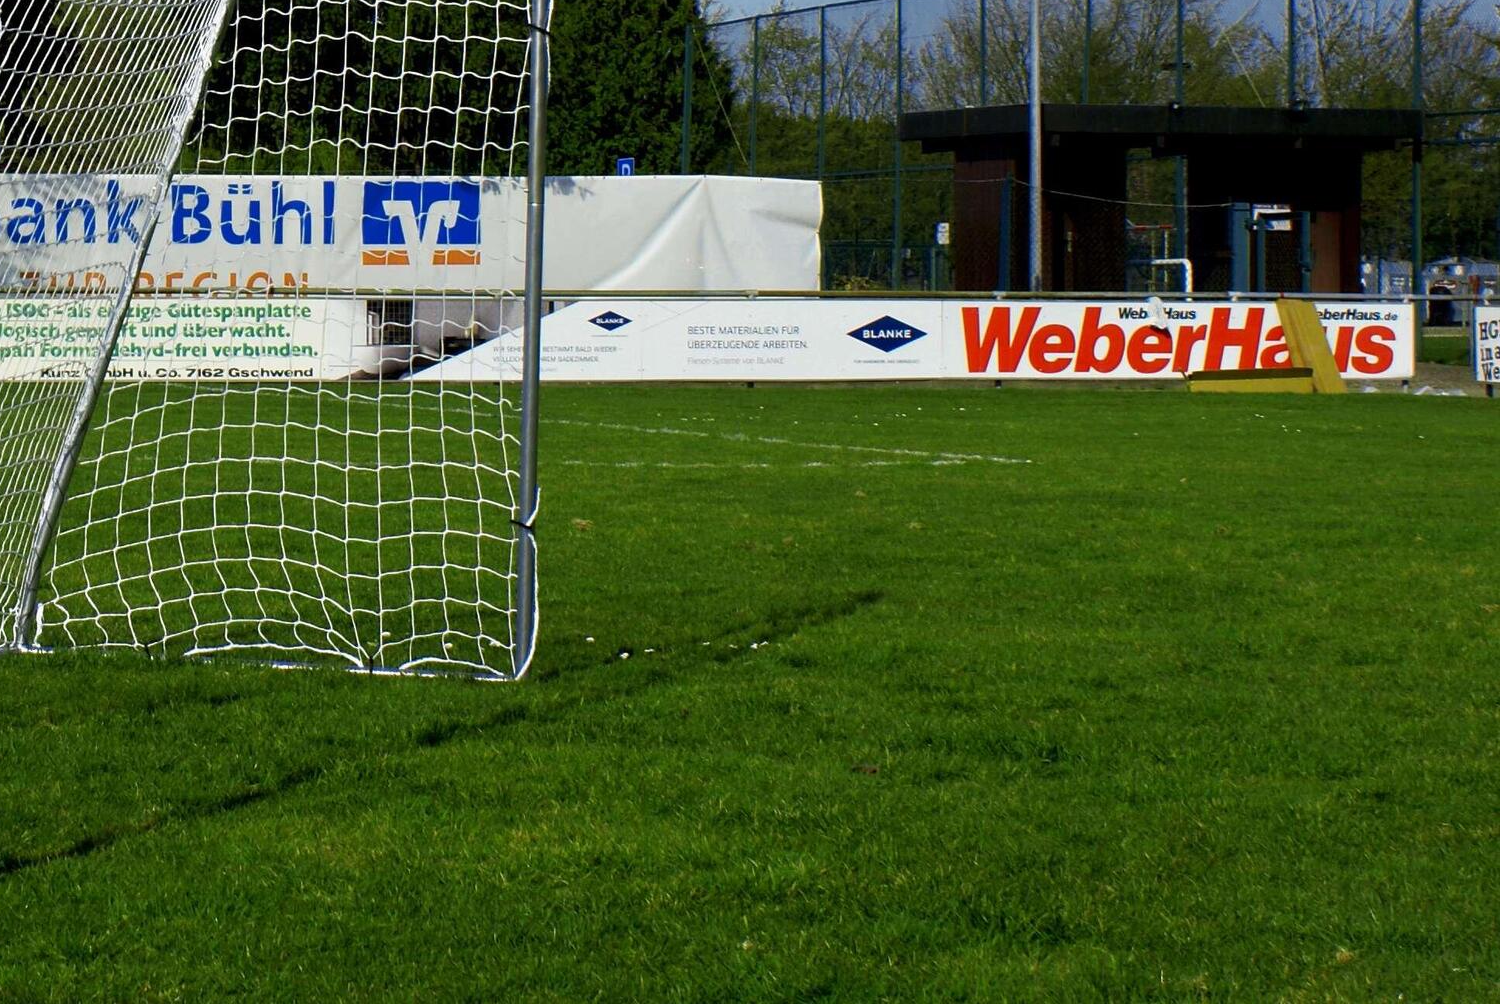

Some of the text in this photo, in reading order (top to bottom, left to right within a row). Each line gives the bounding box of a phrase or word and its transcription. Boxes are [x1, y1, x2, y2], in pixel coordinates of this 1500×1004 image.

[171, 180, 336, 245] Bühl
[68, 303, 91, 318] als
[167, 303, 311, 322] Gütespanplatte
[141, 323, 177, 338] und
[182, 323, 290, 338] überwacht.
[687, 325, 716, 335] BESTE
[718, 325, 779, 335] MATERIALIEN
[863, 329, 911, 338] BLANKE
[212, 342, 318, 357] verbunden.
[186, 368, 224, 378] 7162
[228, 368, 313, 378] Gschwend
